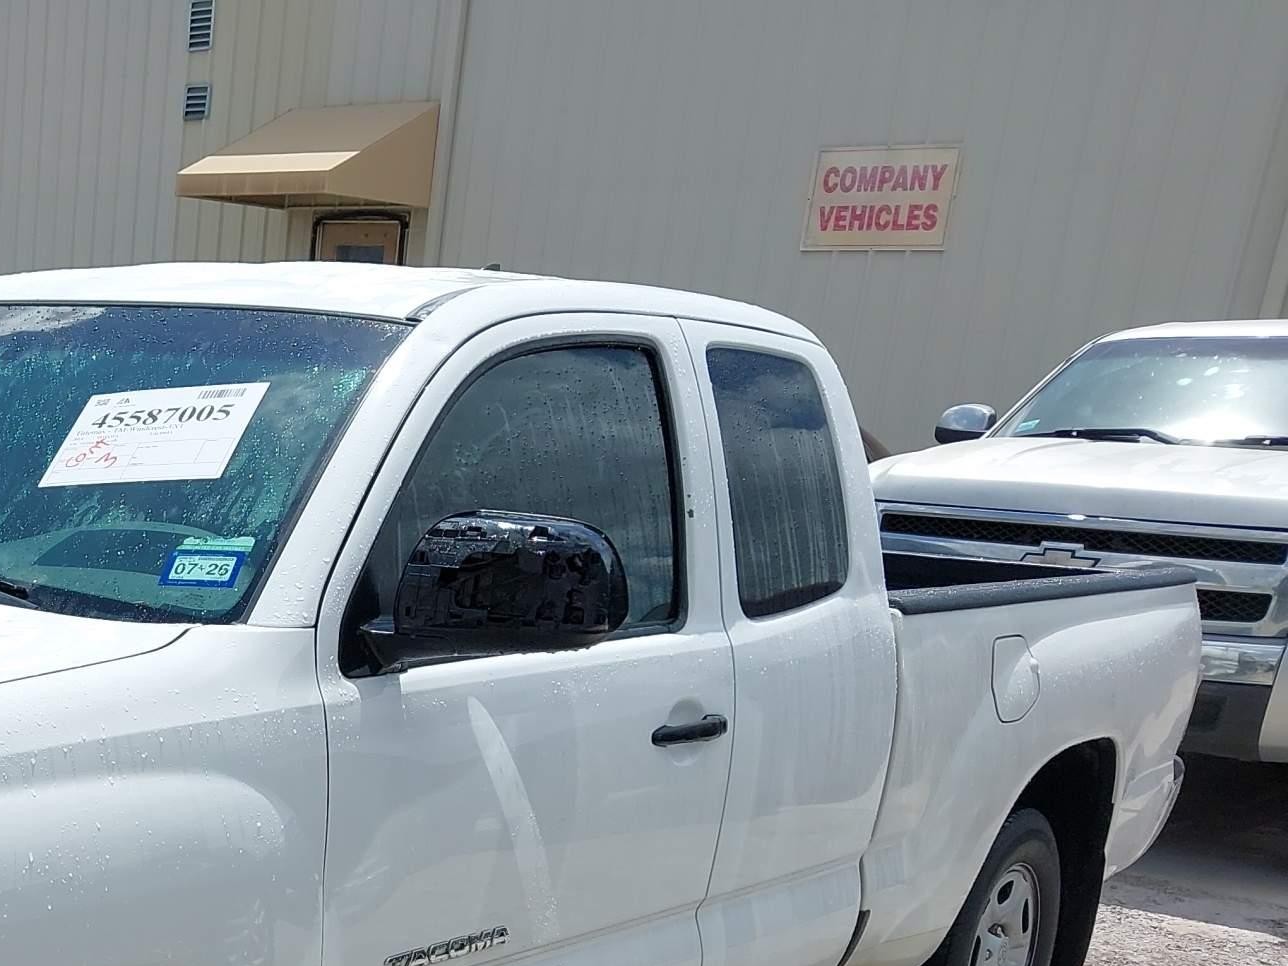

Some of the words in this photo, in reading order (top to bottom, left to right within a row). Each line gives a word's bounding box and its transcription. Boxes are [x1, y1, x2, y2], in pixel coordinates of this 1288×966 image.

[823, 164, 948, 193] COMPANY
[819, 204, 939, 231] VEHICLES
[91, 404, 235, 429] 45587005
[174, 562, 199, 575] 07
[205, 563, 231, 576] 26
